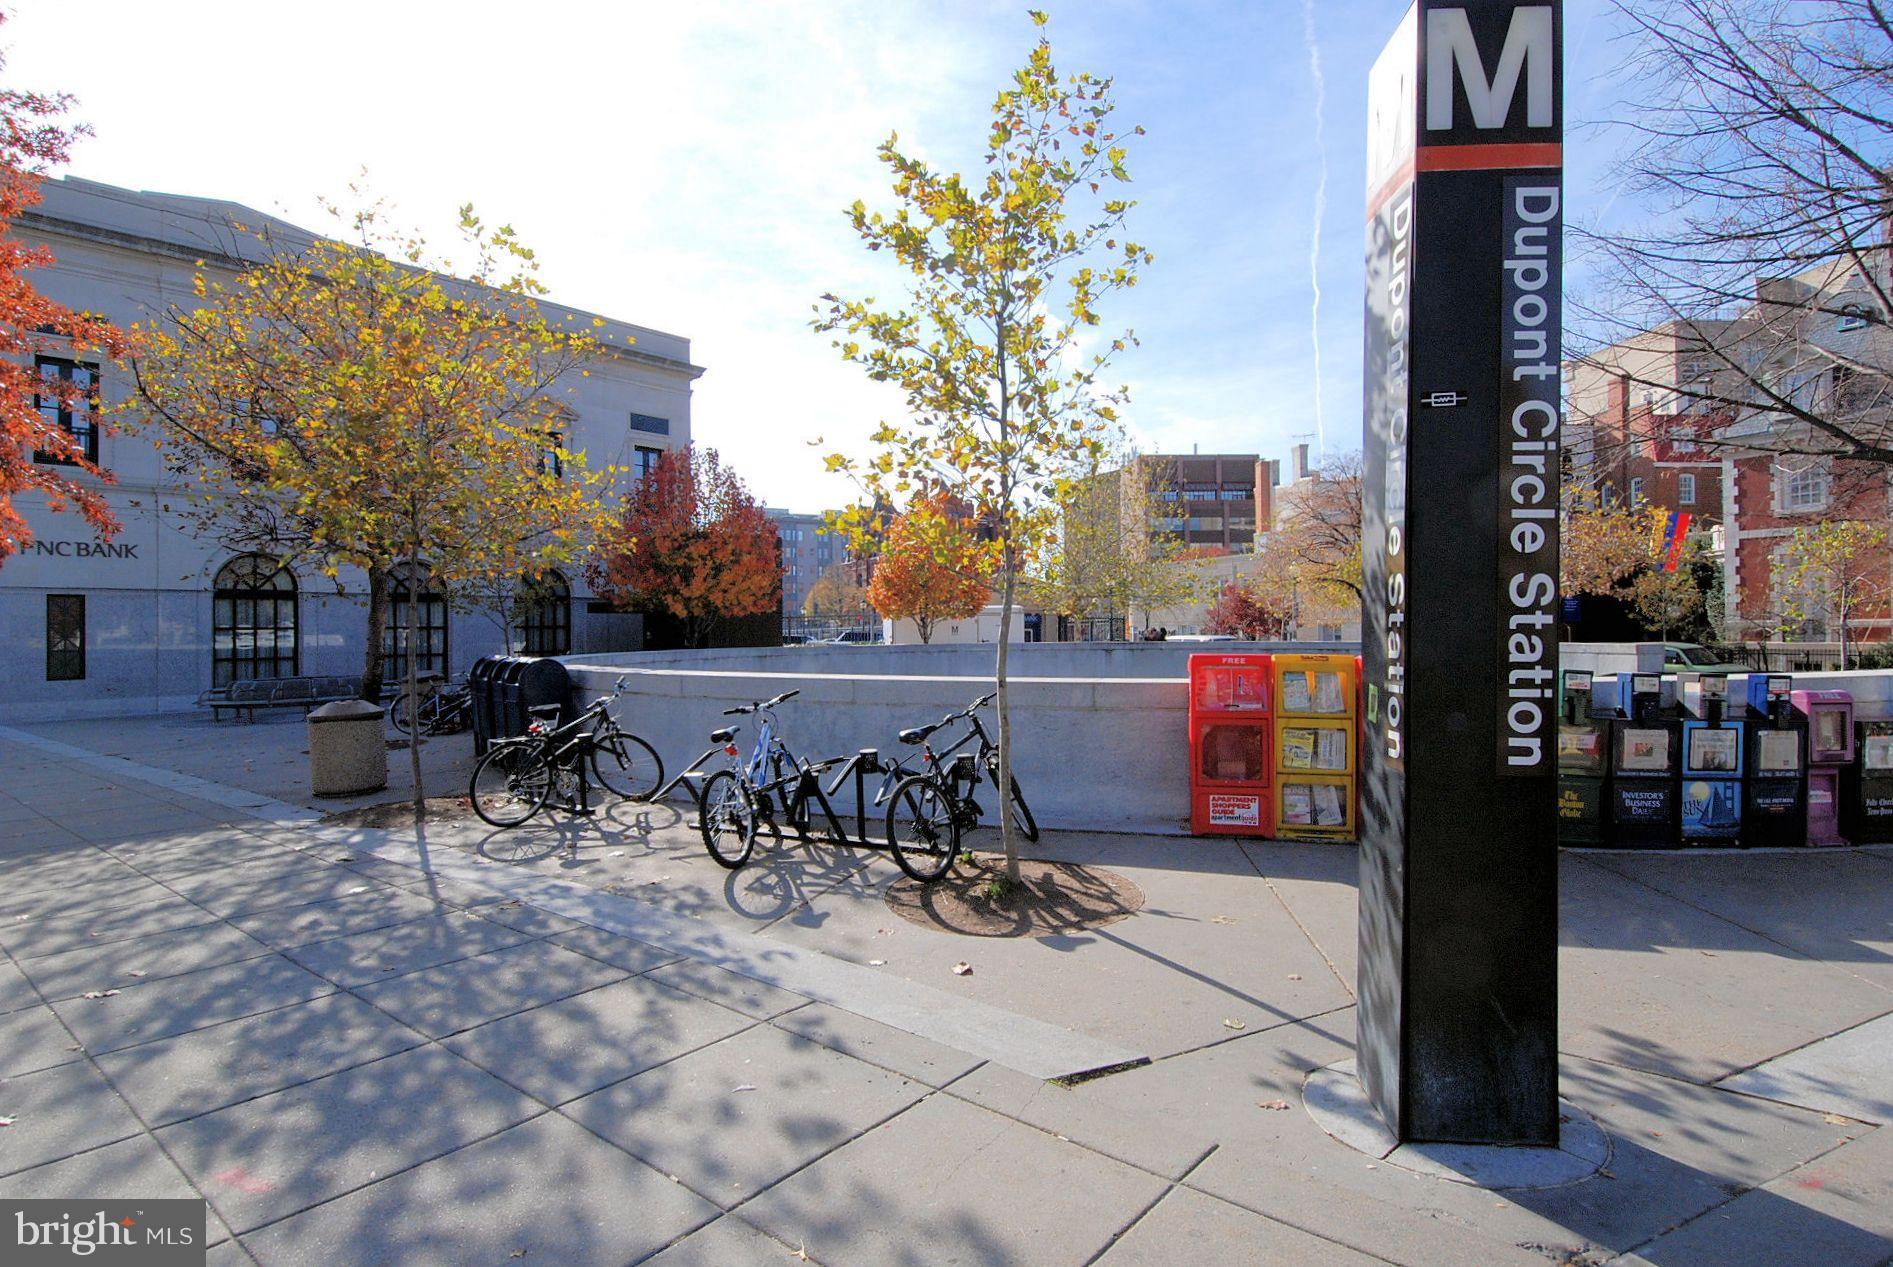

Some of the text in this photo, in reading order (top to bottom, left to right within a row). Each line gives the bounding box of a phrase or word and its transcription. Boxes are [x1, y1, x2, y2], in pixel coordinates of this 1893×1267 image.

[1426, 5, 1554, 131] M
[1388, 196, 1411, 389] Dupont
[1503, 186, 1560, 766] Dupont Circle Station
[74, 541, 139, 559] BANK
[1387, 573, 1405, 759] Station
[1622, 790, 1664, 800] INVESTOR'S
[1625, 799, 1661, 808] BUSINESS
